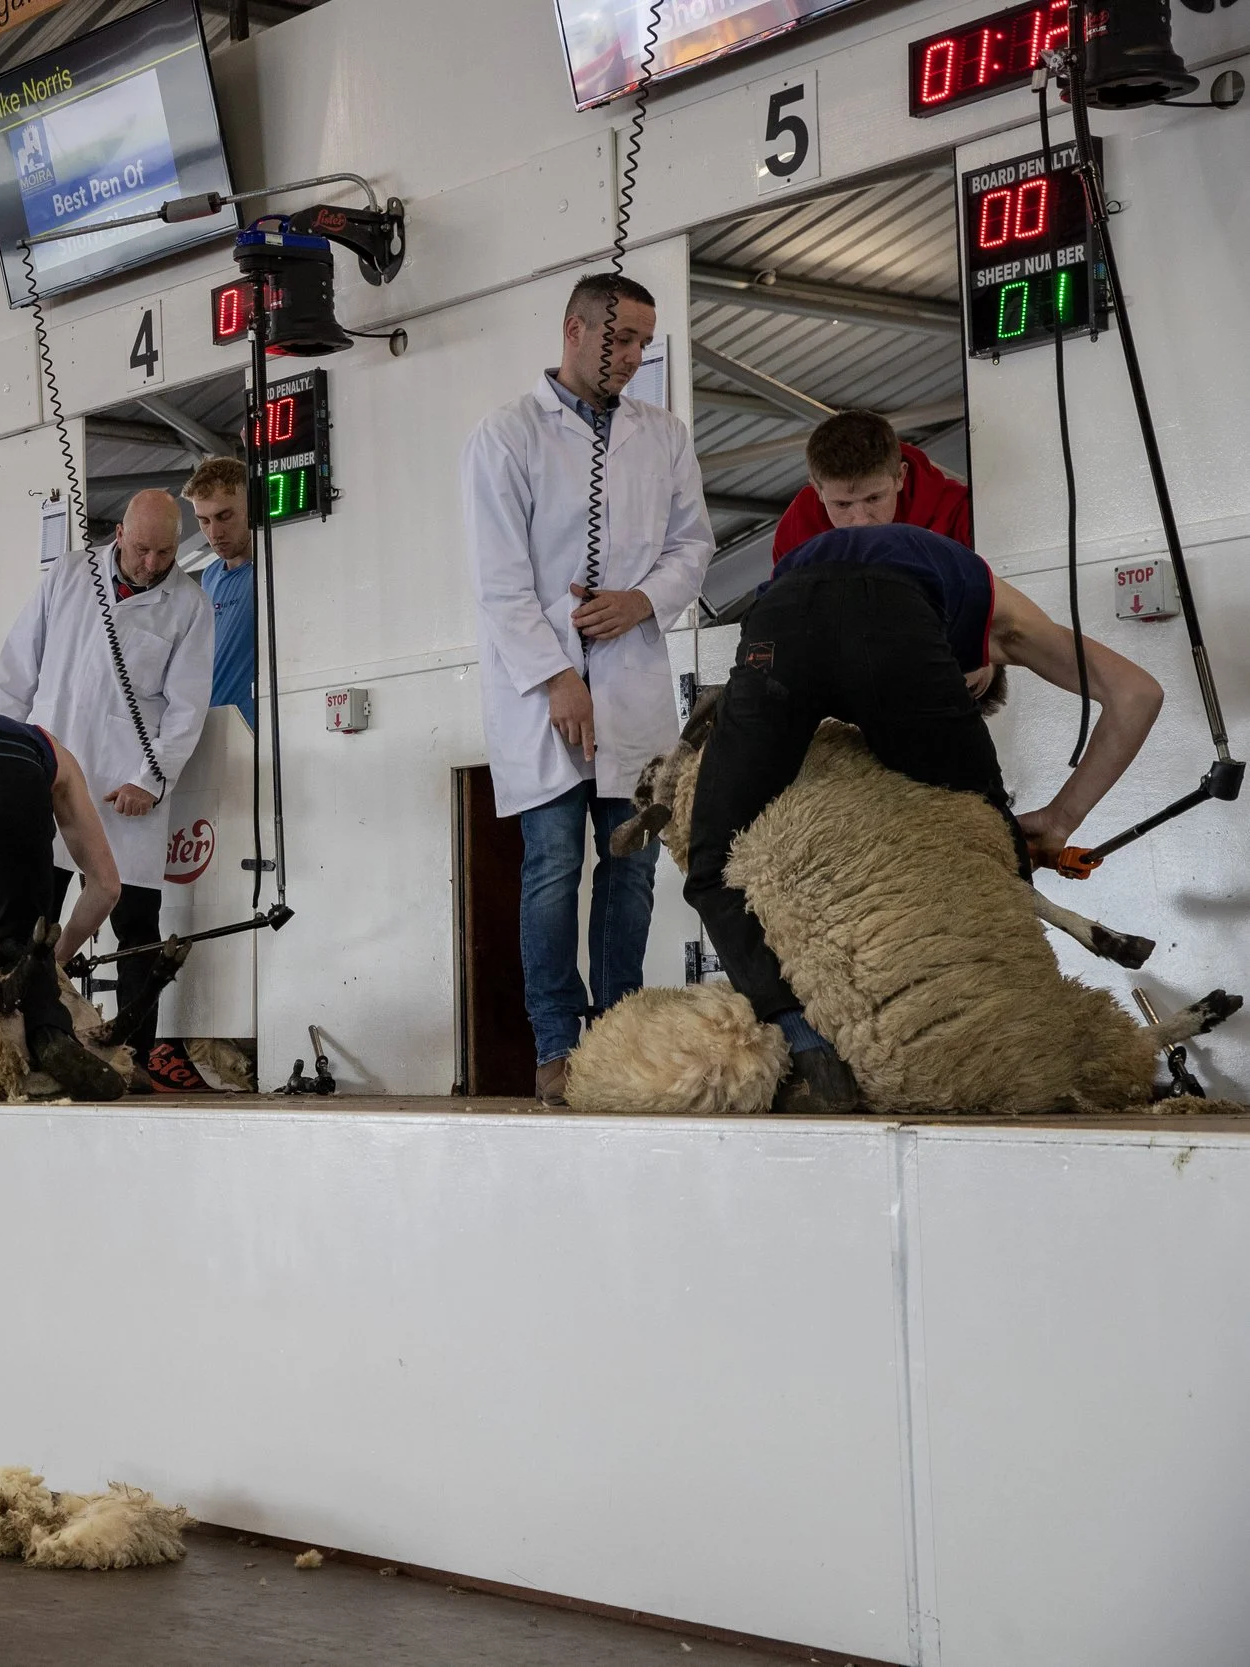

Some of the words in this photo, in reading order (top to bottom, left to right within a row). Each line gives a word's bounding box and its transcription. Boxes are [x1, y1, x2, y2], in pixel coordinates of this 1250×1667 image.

[22, 66, 73, 107] Norris
[765, 84, 809, 177] 5
[20, 167, 54, 190] MOIRA
[52, 186, 89, 217] Best
[89, 178, 121, 202] Pen
[124, 160, 144, 191] Of
[972, 166, 1015, 194] BOARD
[1019, 147, 1078, 179] PENLTY
[312, 208, 347, 232] Lister
[980, 179, 1047, 248] 00
[977, 261, 1020, 288] SHEEP
[998, 272, 1066, 338] 01
[130, 309, 158, 377] 4
[280, 451, 315, 471] NUMBER
[1118, 567, 1154, 586] STOP
[327, 694, 348, 708] STOP
